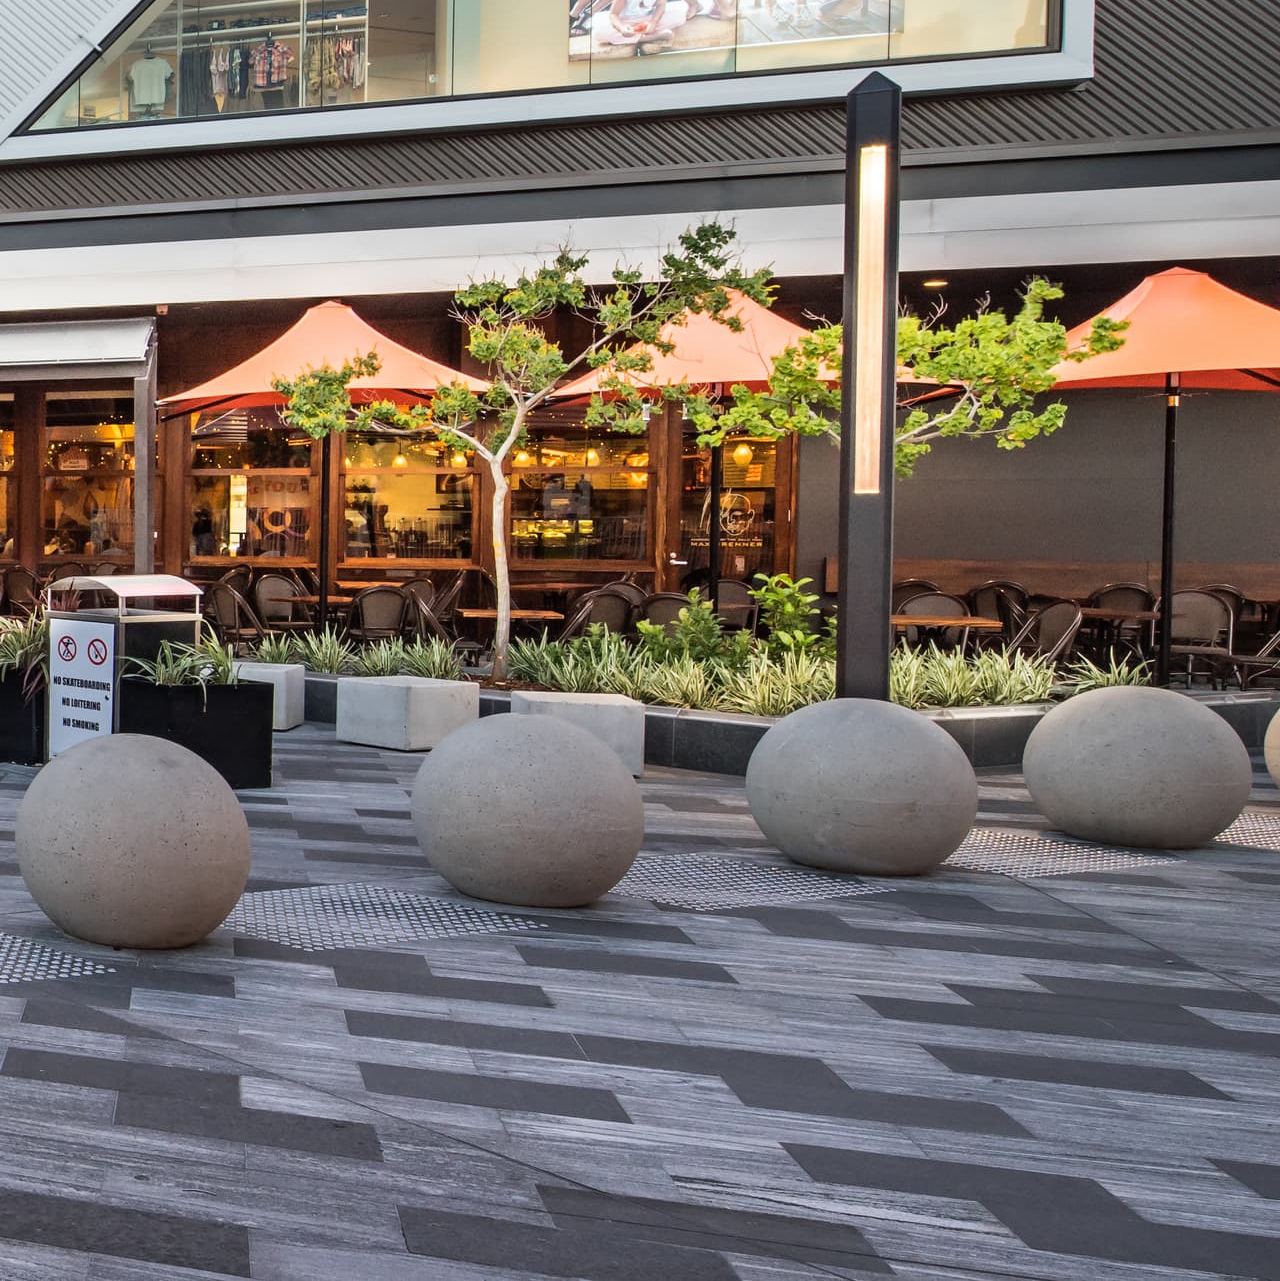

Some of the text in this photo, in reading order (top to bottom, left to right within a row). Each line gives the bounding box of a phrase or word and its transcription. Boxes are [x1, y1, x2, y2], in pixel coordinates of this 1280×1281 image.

[53, 675, 111, 692] NO SKATEBOARDING
[62, 697, 101, 711] NO LOITERING
[63, 717, 99, 732] NO SMOKING
